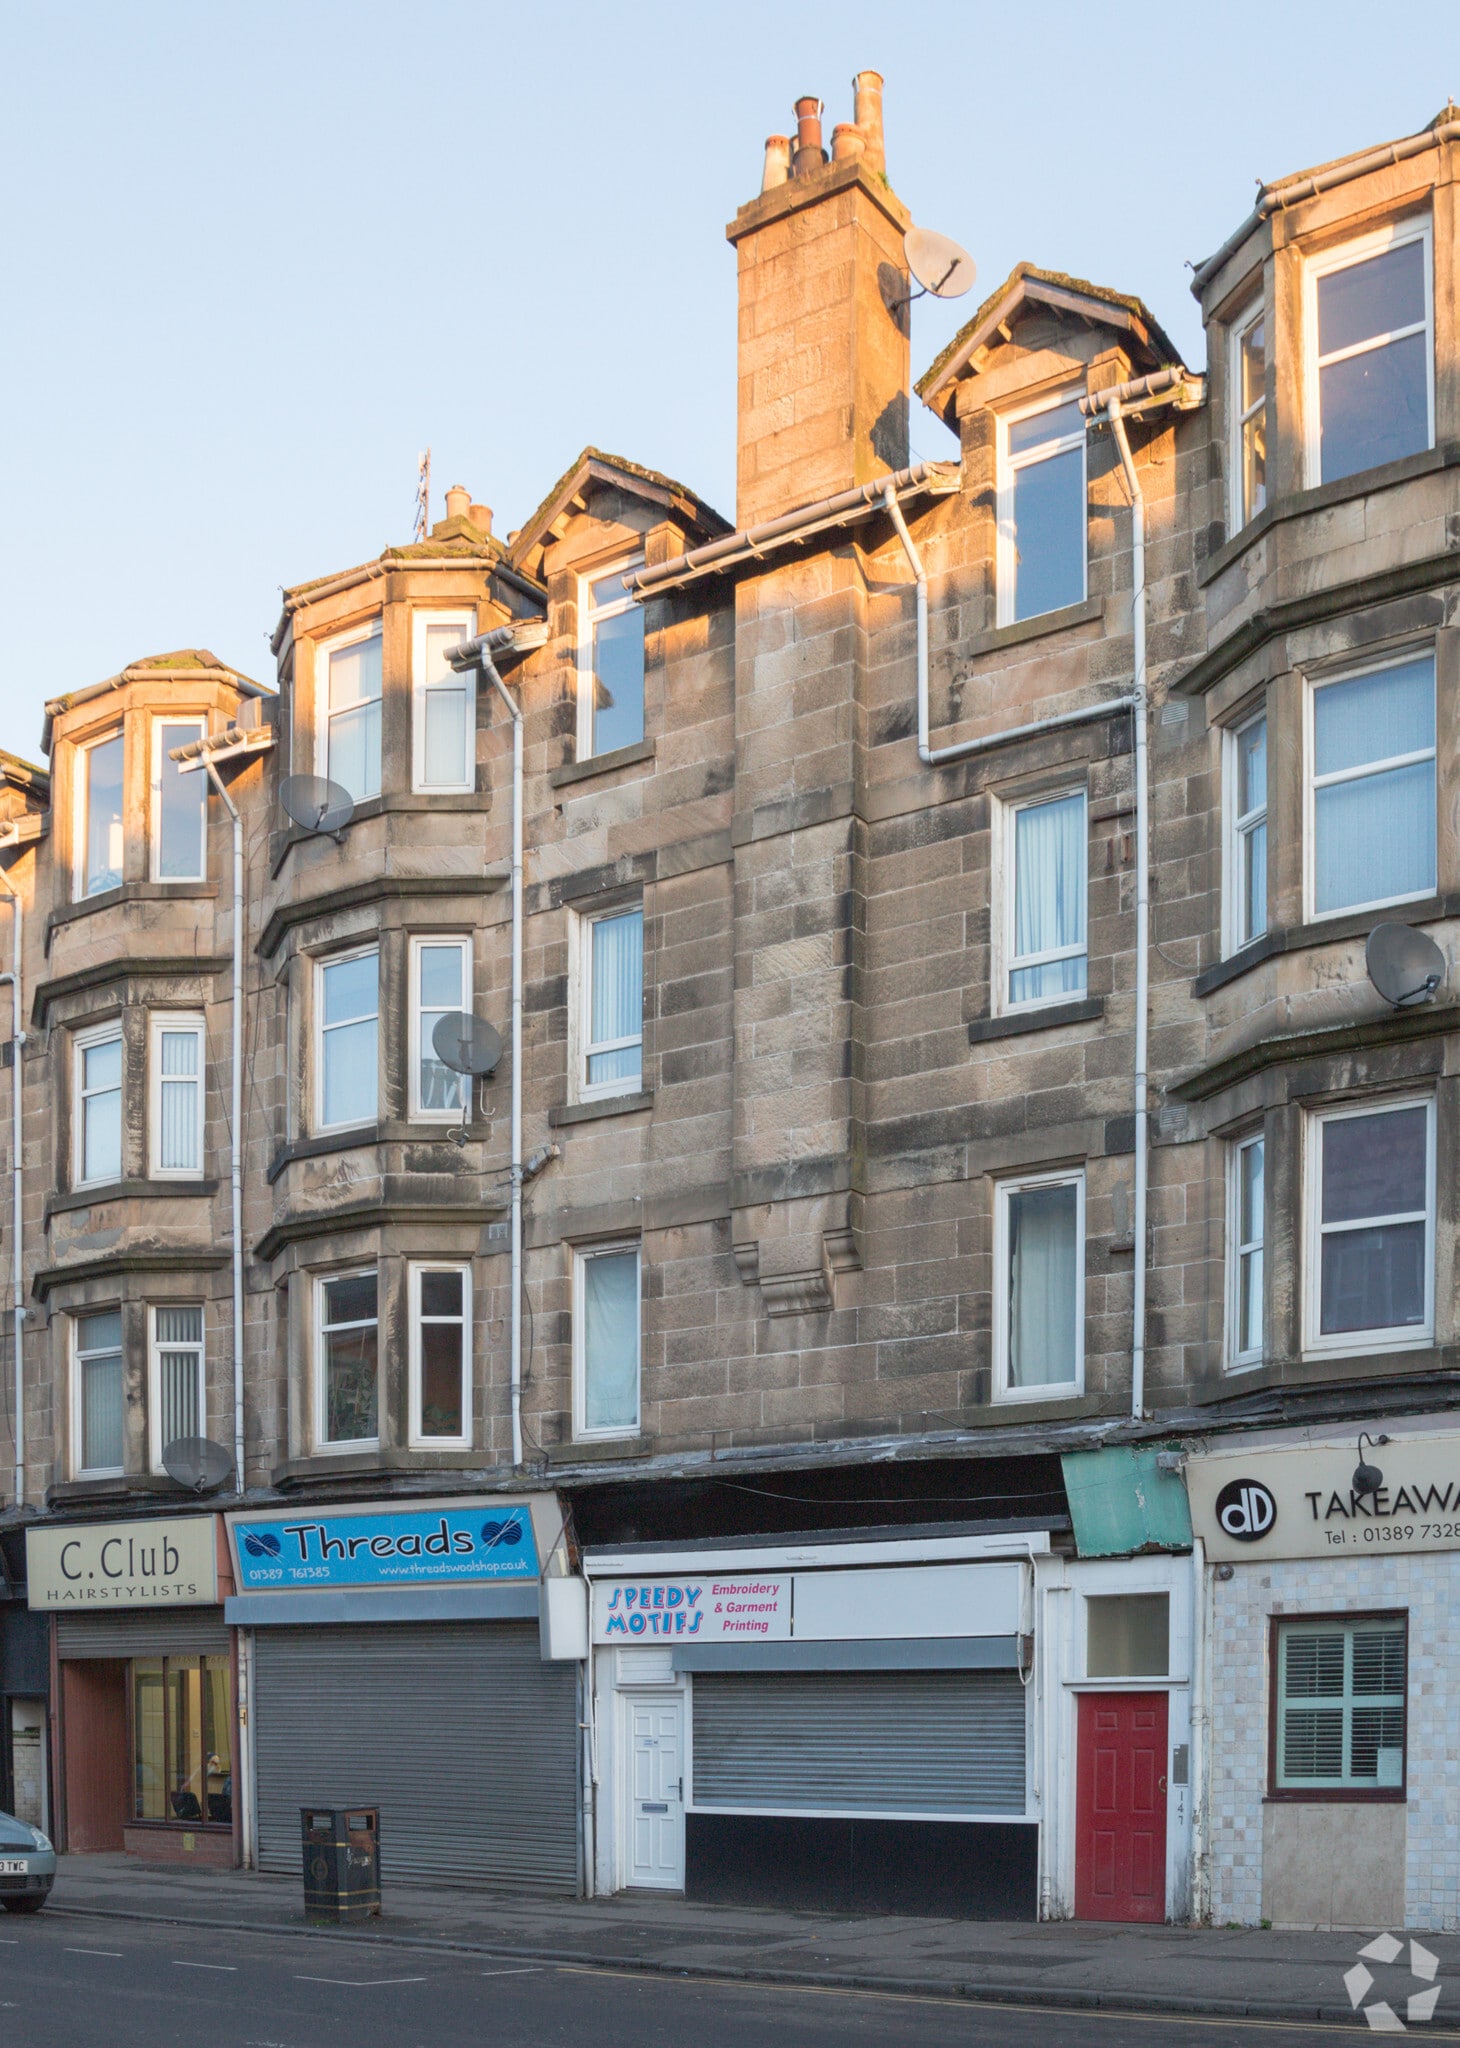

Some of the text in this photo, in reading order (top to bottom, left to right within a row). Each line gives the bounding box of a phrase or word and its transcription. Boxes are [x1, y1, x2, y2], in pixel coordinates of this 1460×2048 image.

[283, 1517, 475, 1561] Threads
[1325, 1530, 1346, 1544] Tel
[1363, 1526, 1414, 1542] 01389
[249, 1566, 330, 1580] 01389 761385
[378, 1558, 528, 1575] www.threadswoolshop.co.uk
[47, 1583, 197, 1600] HAIRSTYLISTS
[607, 1585, 703, 1610] SPEEDY
[712, 1583, 780, 1596] Embroidery
[714, 1601, 778, 1613] & Garment
[605, 1610, 704, 1635] MOTIFS
[722, 1620, 769, 1633] Printing
